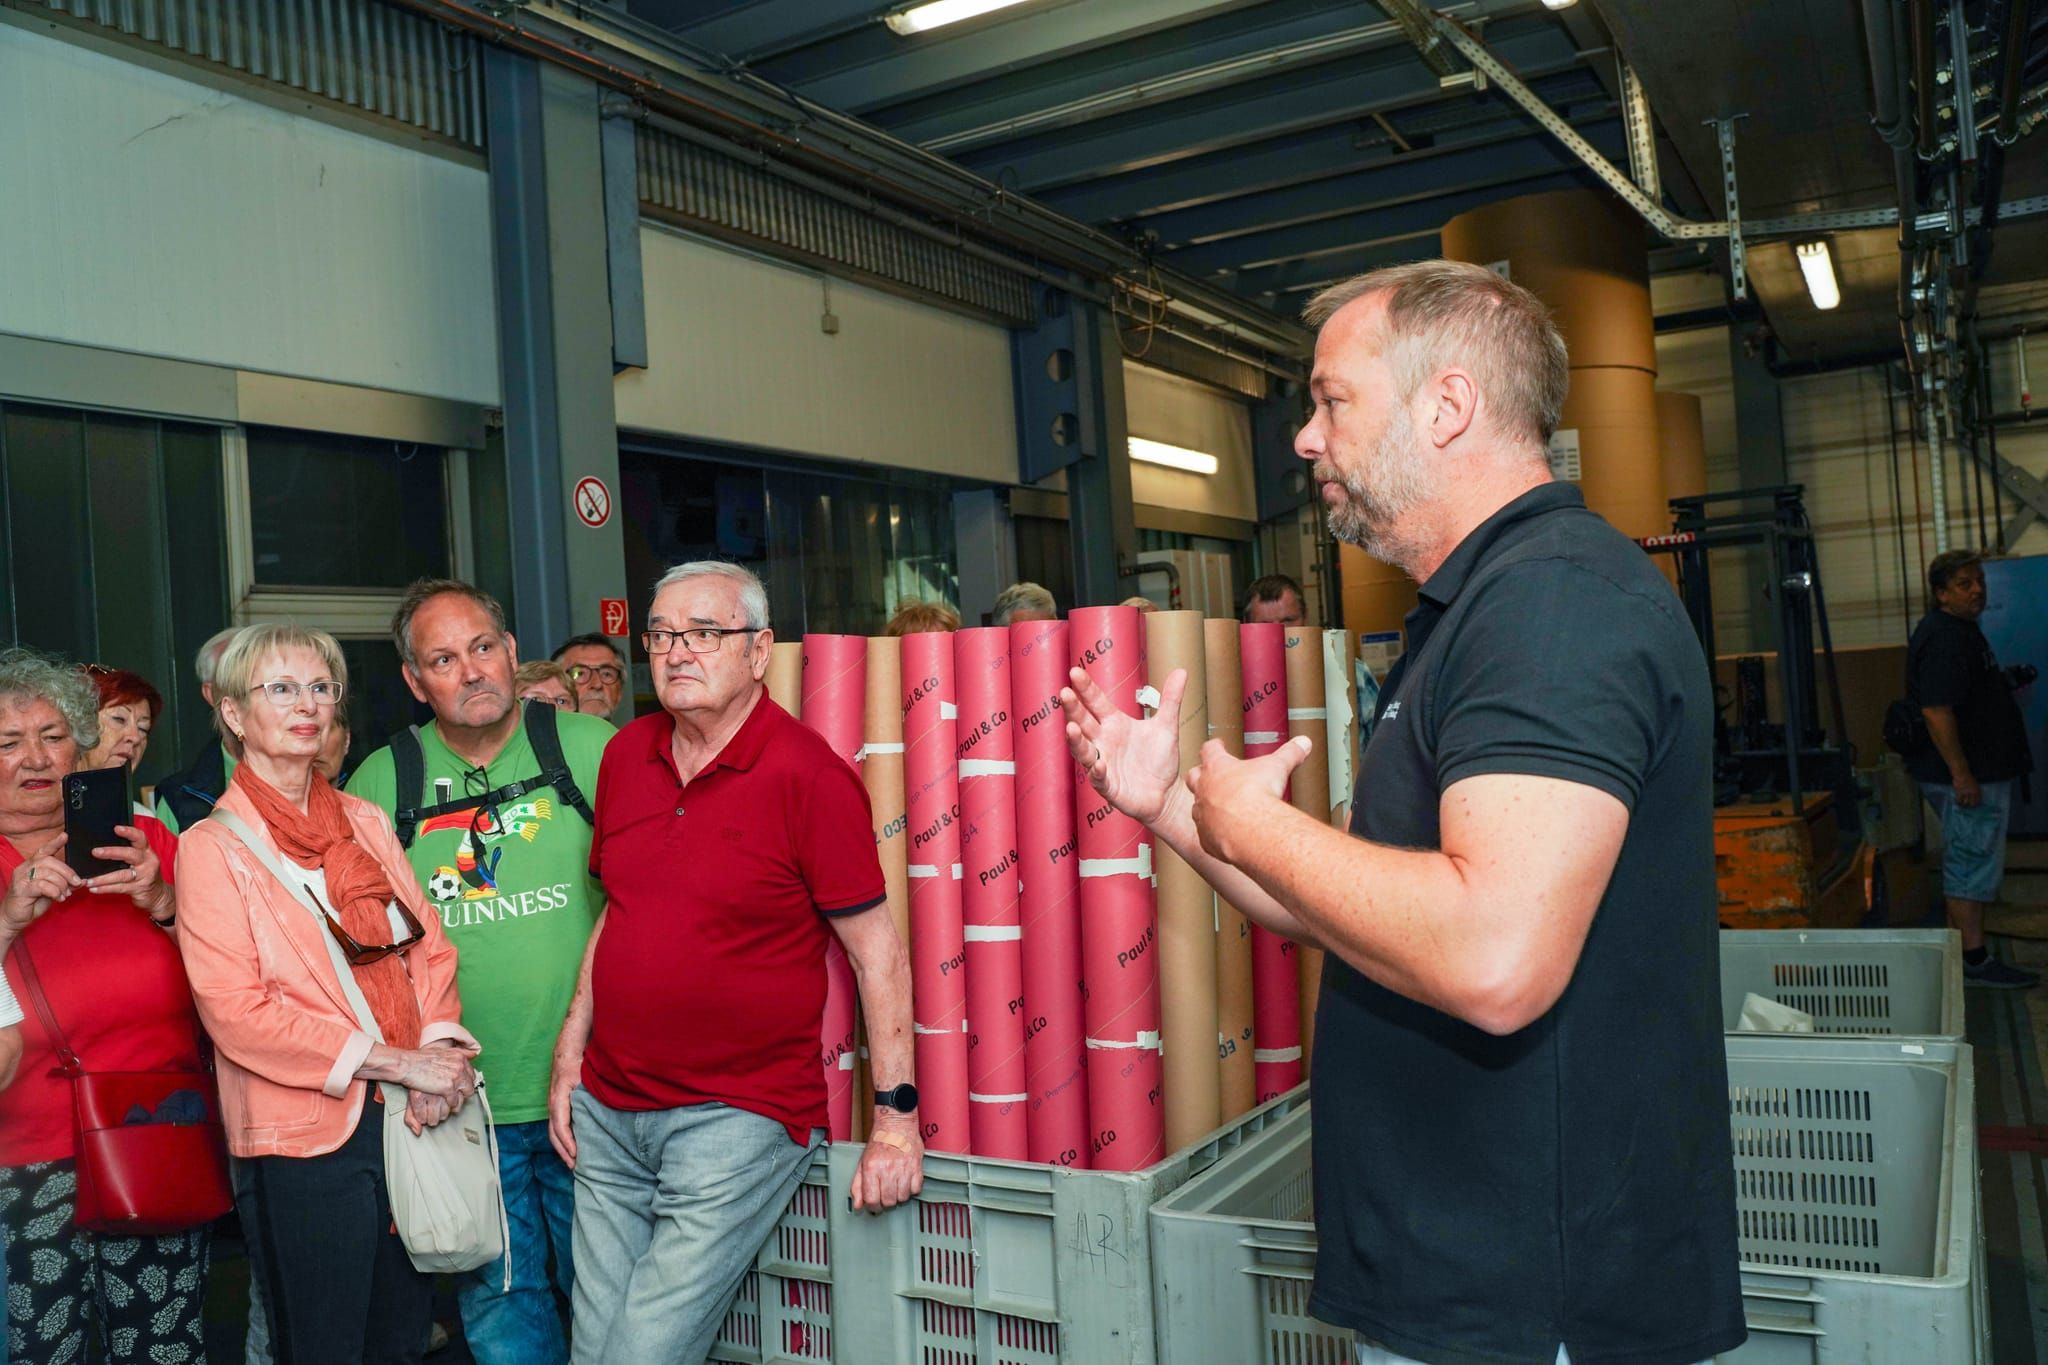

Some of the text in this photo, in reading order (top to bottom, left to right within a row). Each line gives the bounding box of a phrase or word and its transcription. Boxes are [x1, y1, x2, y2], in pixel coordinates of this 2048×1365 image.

[1096, 638, 1113, 655] Co
[913, 687, 925, 701] &
[922, 677, 939, 694] Co
[1253, 690, 1265, 703] &
[1264, 681, 1278, 696] Co
[981, 721, 993, 735] &
[991, 710, 1007, 727] Co
[1021, 695, 1062, 733] Paul &
[914, 819, 943, 849] Paul
[941, 812, 953, 827] &
[951, 804, 960, 819] C
[1086, 803, 1114, 829] Pau
[1048, 832, 1078, 864] Paul
[979, 856, 1009, 886] Paul
[431, 884, 568, 928] UINNESS
[1117, 934, 1148, 968] Paul
[1033, 1016, 1047, 1034] Co
[925, 1122, 939, 1138] Co
[1101, 1130, 1116, 1147] Co
[1060, 1149, 1077, 1166] Co
